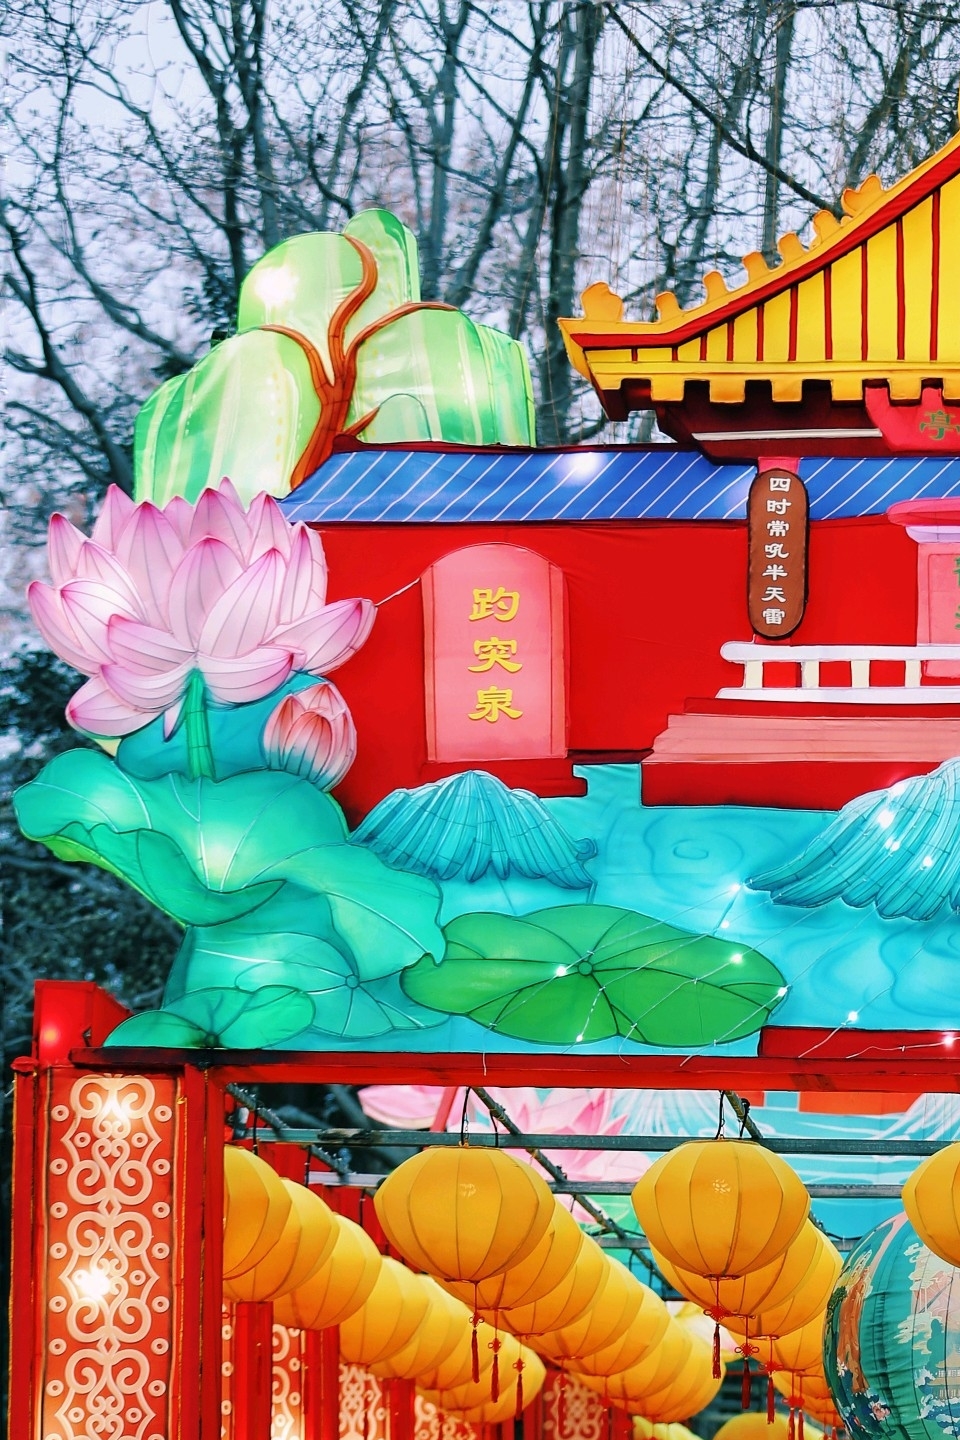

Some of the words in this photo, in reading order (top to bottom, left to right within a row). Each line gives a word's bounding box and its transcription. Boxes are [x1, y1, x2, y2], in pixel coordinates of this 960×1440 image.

[761, 477, 792, 625] 四时常吼半天雷
[467, 586, 524, 723] 趵突泉
